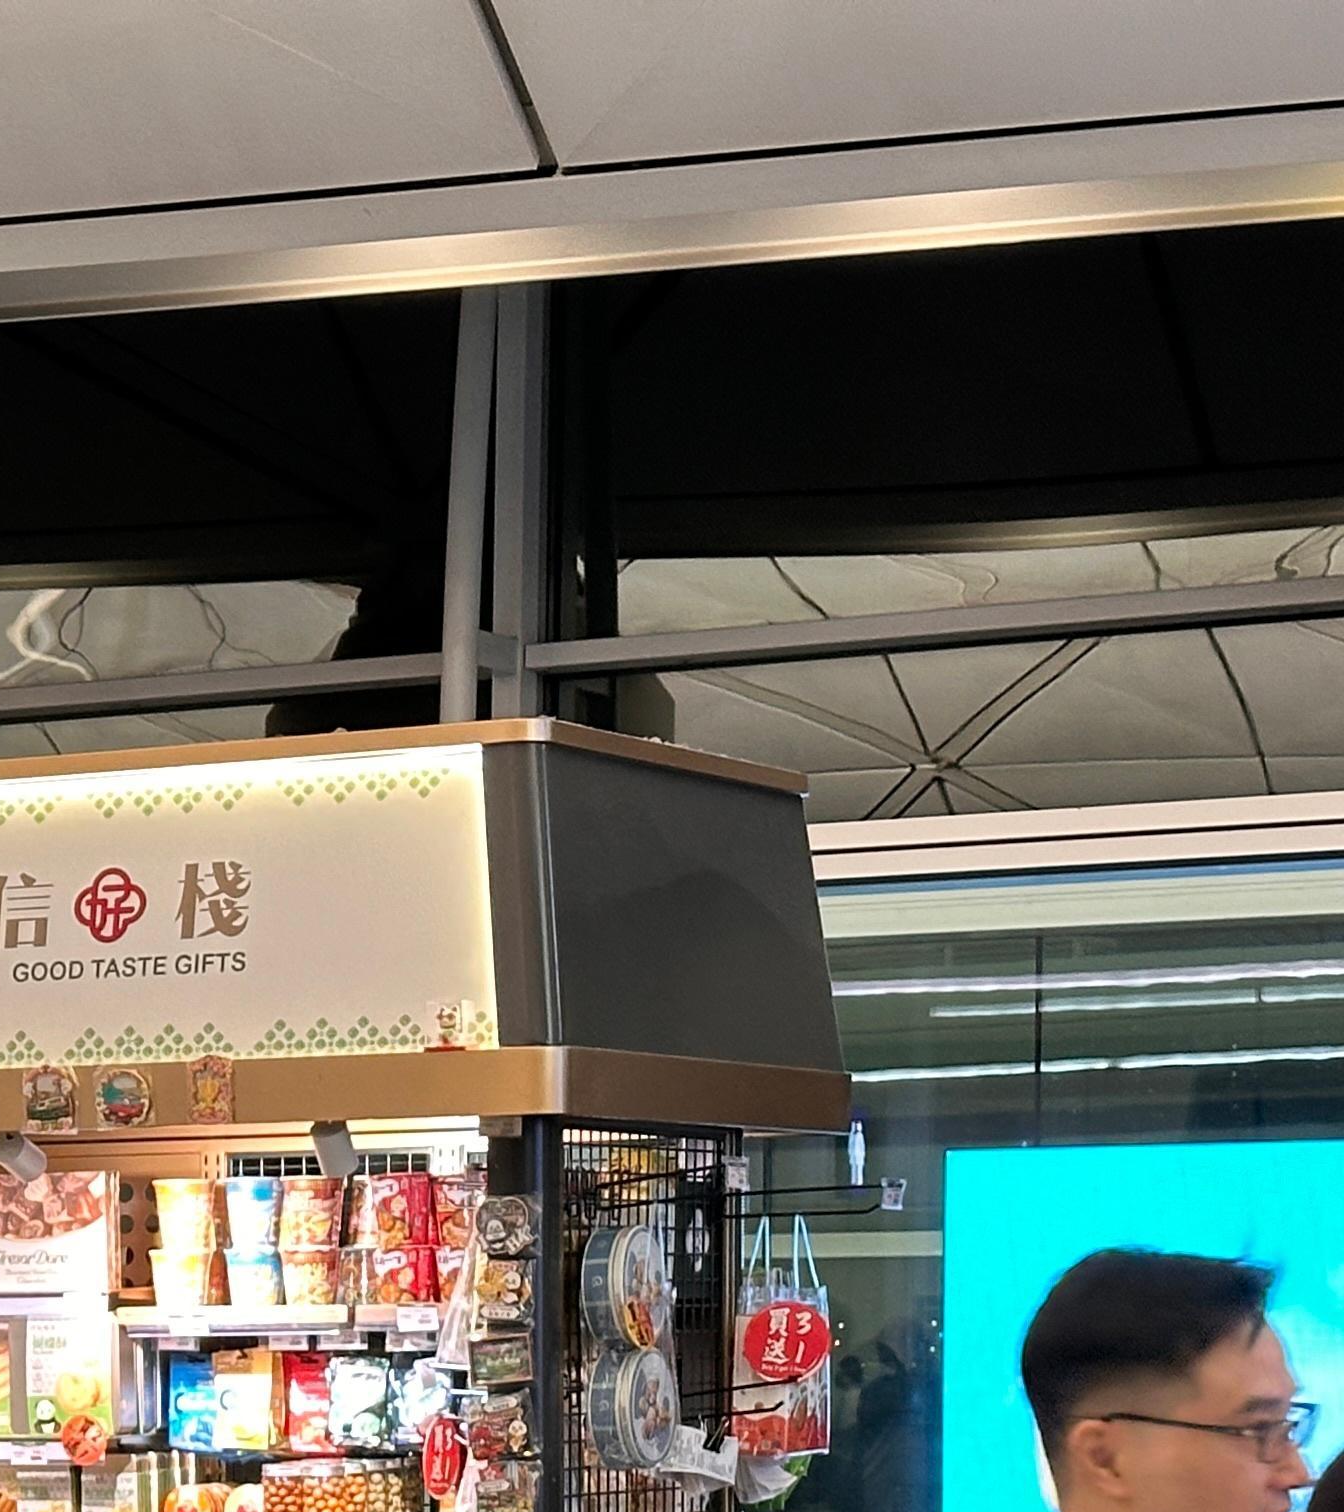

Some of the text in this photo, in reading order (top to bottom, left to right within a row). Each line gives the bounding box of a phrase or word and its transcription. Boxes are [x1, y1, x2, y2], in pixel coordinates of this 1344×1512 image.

[12, 951, 247, 983] GOOD TASTE GIFTS
[768, 1306, 814, 1338] 買3
[761, 1337, 806, 1364] 送1
